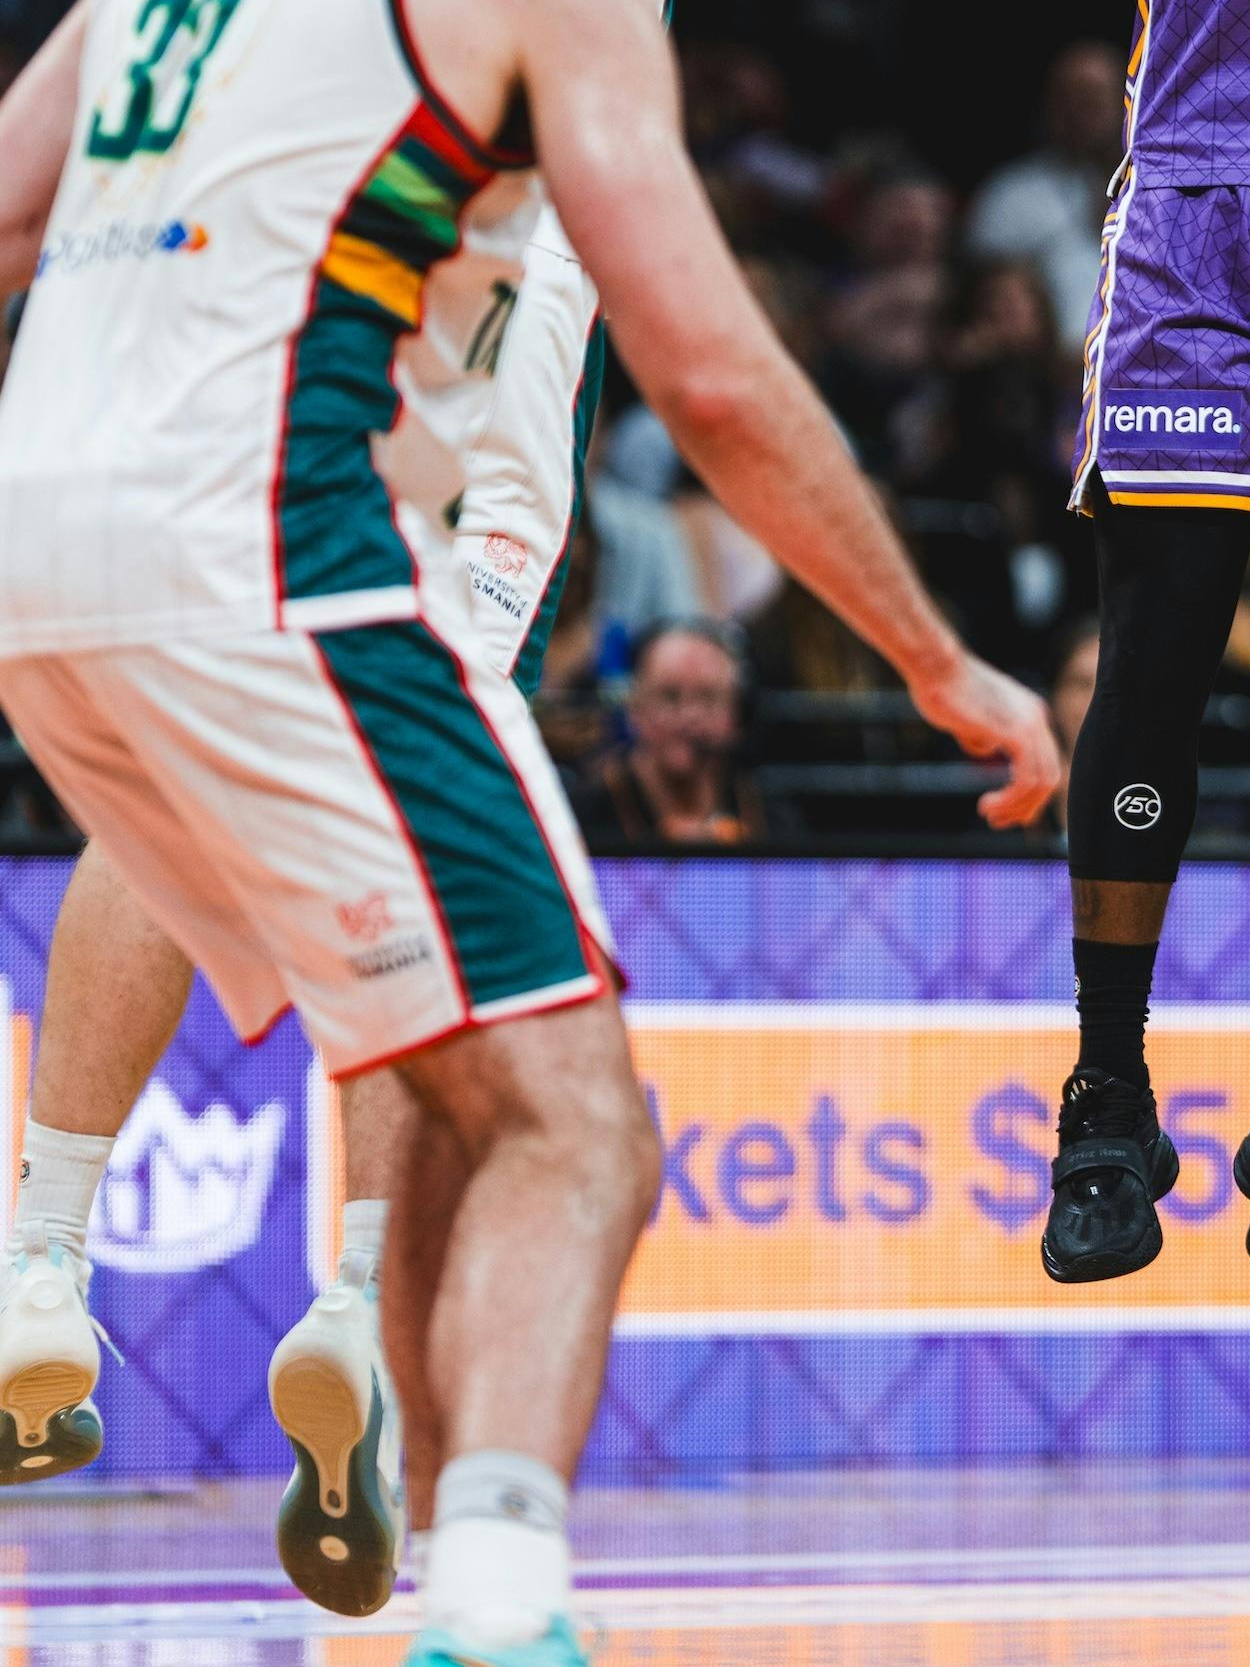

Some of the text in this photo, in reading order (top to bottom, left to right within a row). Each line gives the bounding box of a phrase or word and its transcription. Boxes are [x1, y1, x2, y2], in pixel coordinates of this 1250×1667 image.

[466, 560, 521, 602] NIVERSITY
[472, 578, 521, 620] SMANIA
[645, 1077, 930, 1226] kets
